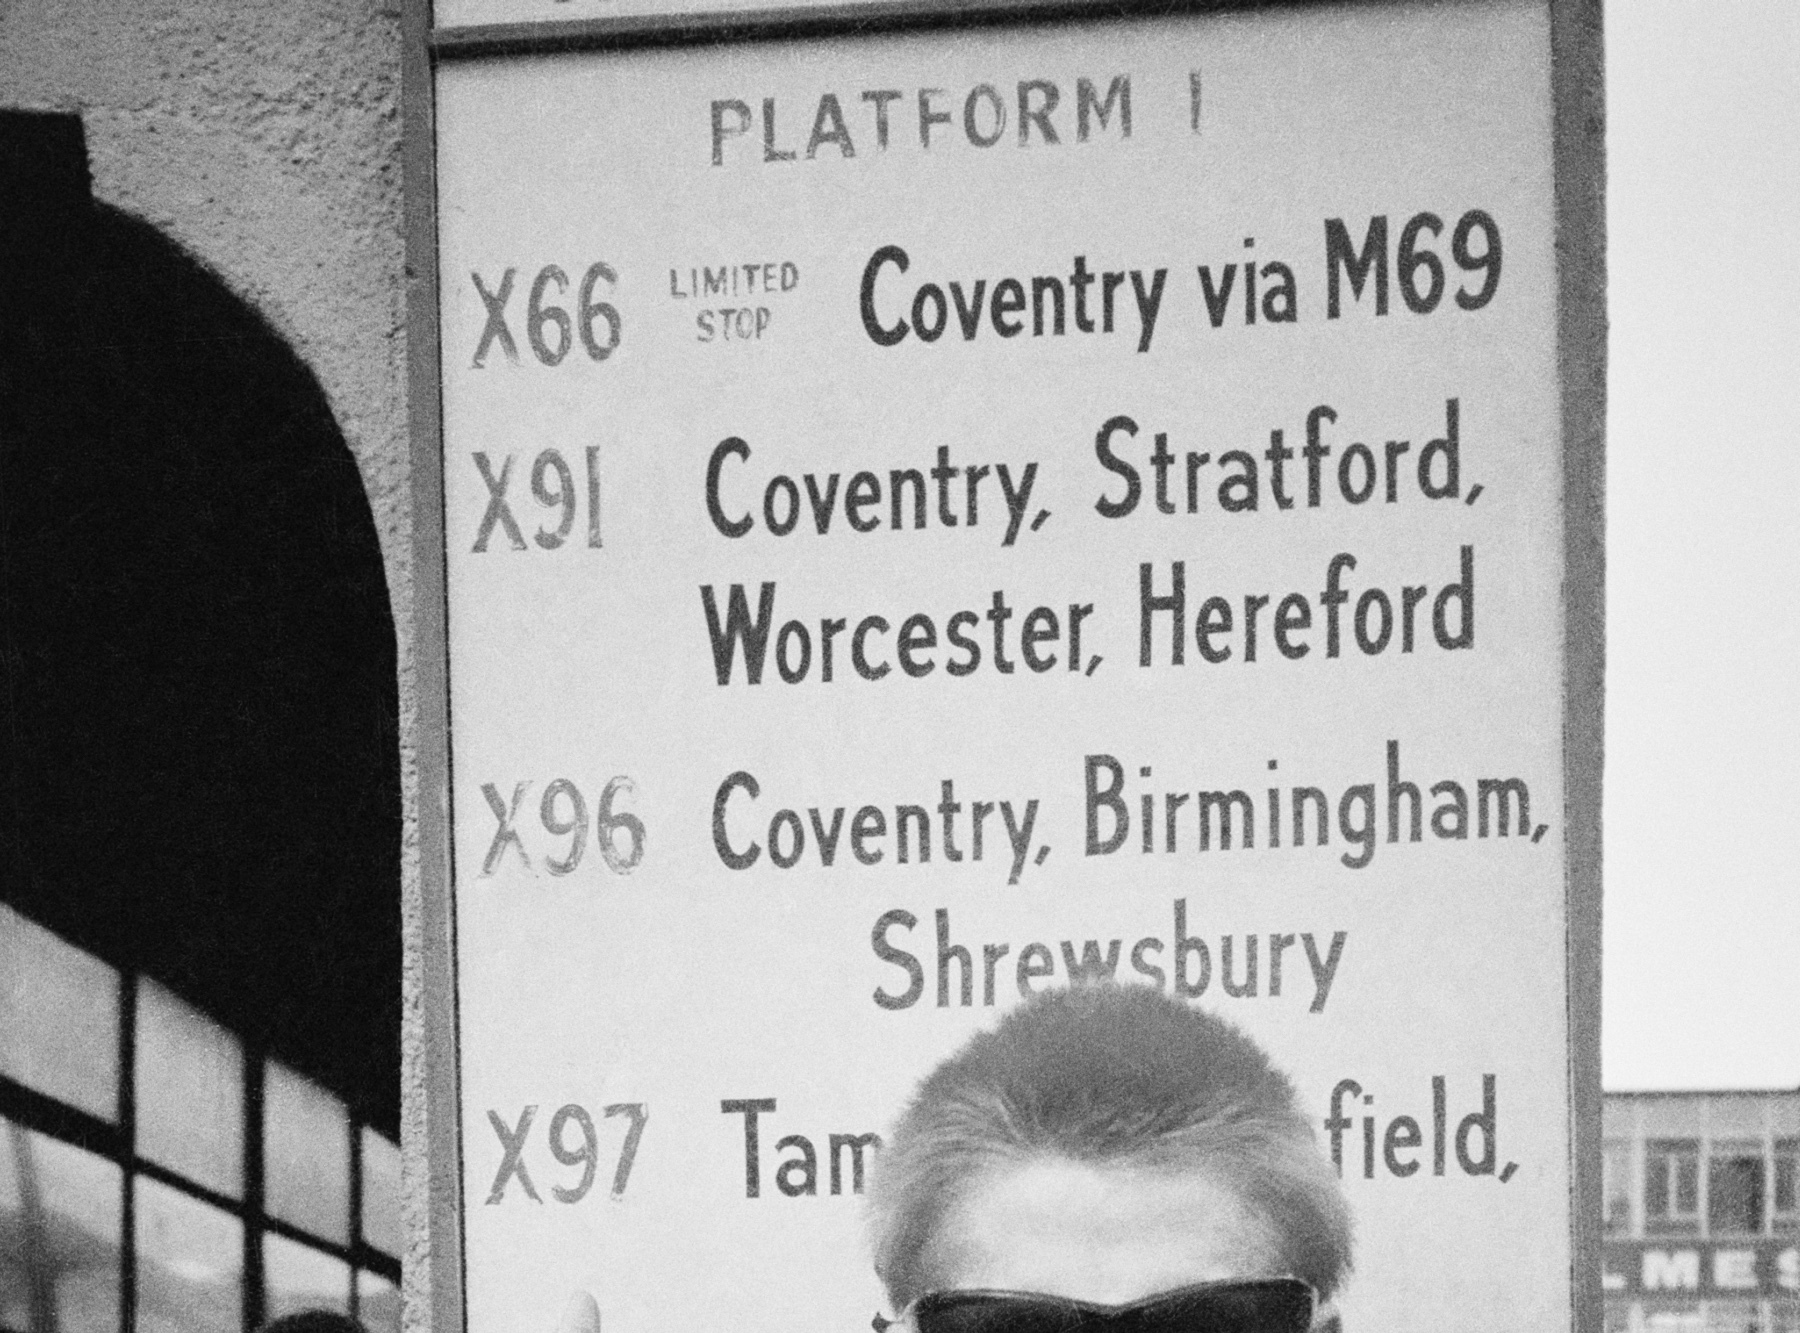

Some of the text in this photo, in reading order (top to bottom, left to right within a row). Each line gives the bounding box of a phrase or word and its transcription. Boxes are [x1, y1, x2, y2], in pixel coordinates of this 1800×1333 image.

[710, 73, 1133, 167] PLATFORM
[471, 261, 622, 369] X66
[669, 261, 800, 299] LIMITED
[696, 306, 772, 342] STOP
[858, 208, 1504, 354] Coventry via M69
[472, 445, 603, 553] X91
[704, 397, 1485, 548] Coventry, Stratford,
[698, 544, 1475, 687] Worcester, Hereford
[480, 775, 647, 879] X96
[711, 738, 1551, 886] Coventry, Birmingham,
[870, 898, 1348, 1014] Shrewsbury
[486, 1101, 650, 1206] X97
